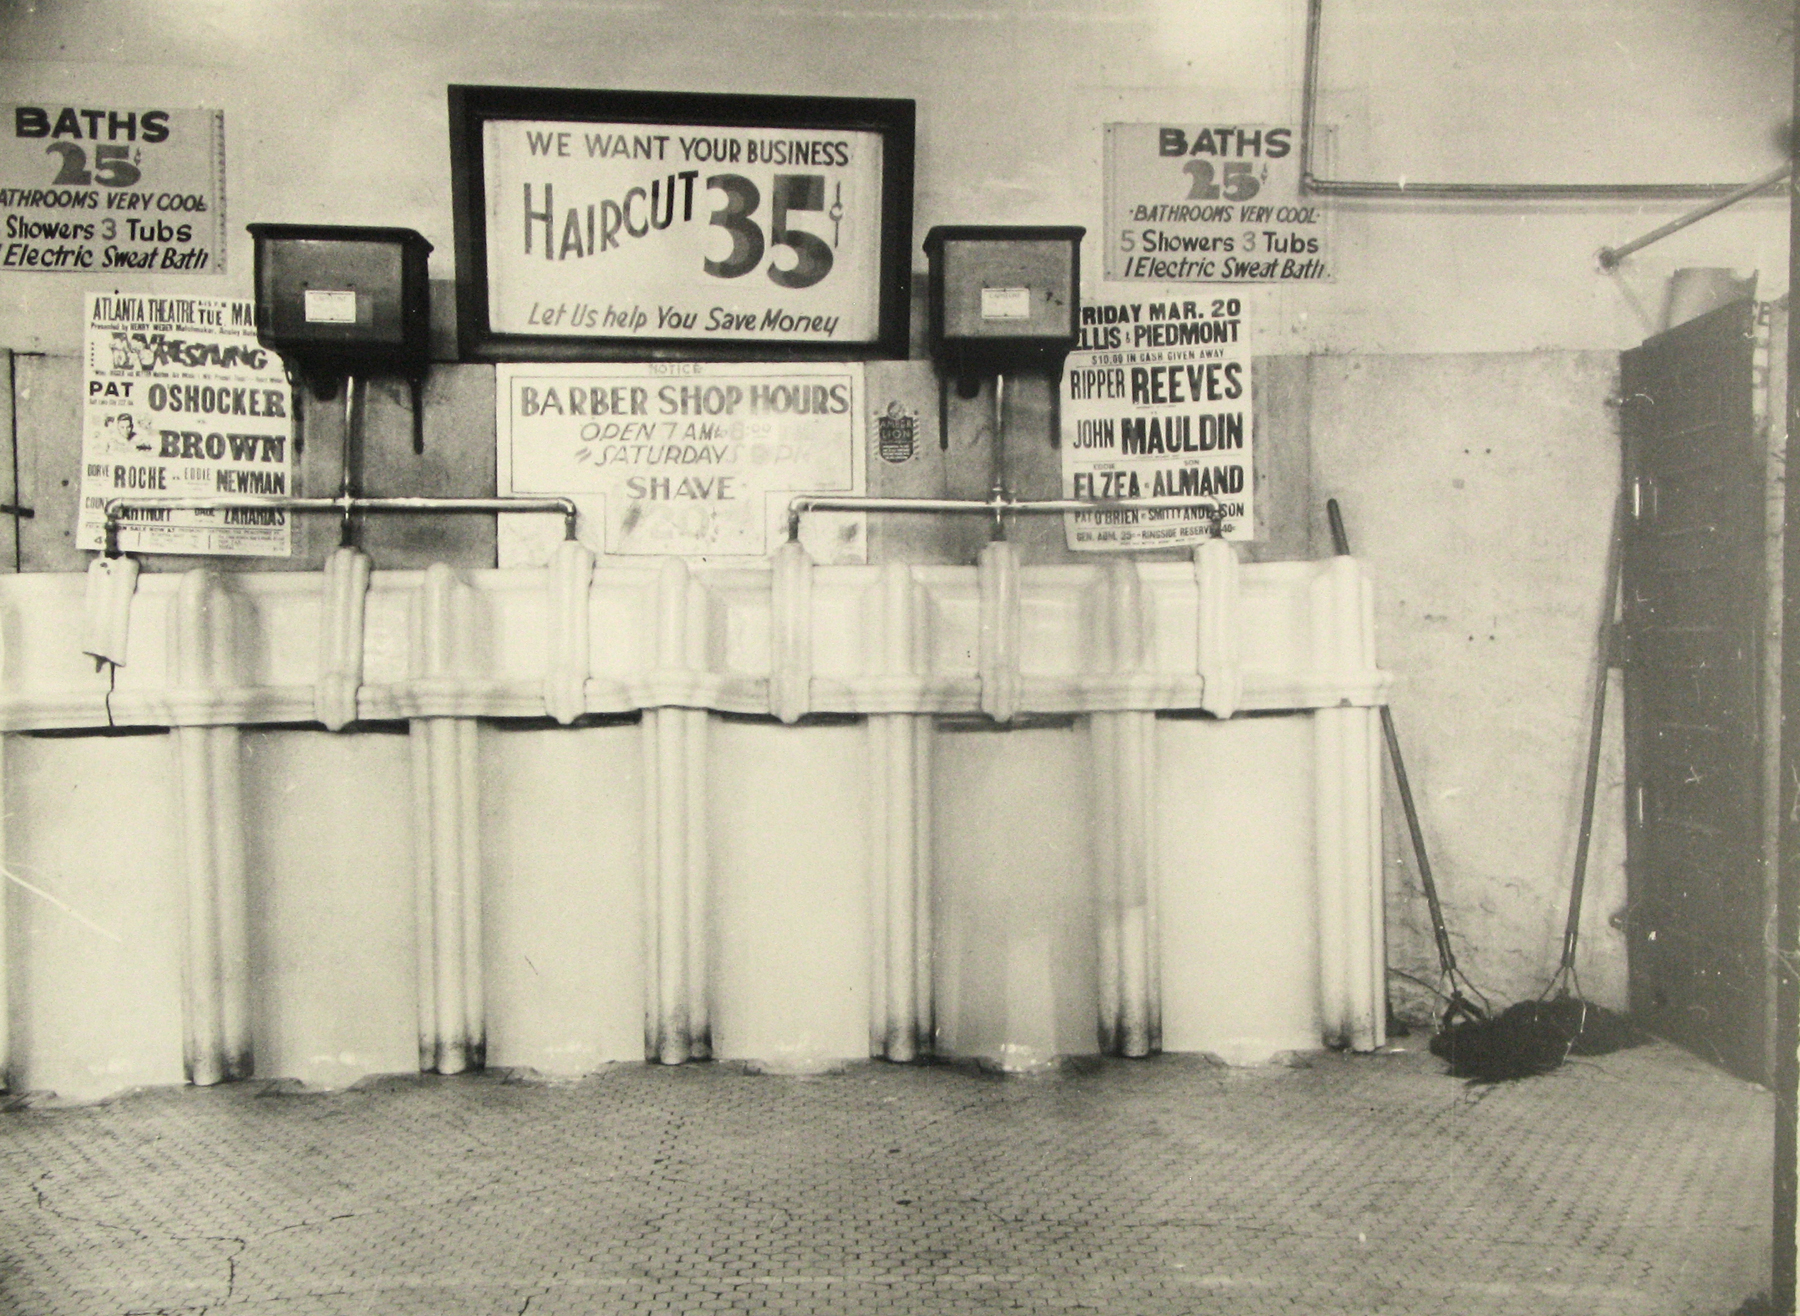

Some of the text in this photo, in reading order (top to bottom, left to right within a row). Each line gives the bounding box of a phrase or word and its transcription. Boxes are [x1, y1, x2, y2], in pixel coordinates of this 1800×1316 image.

[16, 107, 169, 143] BATHS
[526, 131, 849, 167] WE WANT YOUR BUSINESS
[1159, 127, 1292, 158] BATHS
[106, 192, 154, 210] VERY
[523, 169, 699, 261] HAIRCUT
[1240, 206, 1273, 223] VERY
[7, 214, 192, 242] Showers 3 Tubs
[1120, 228, 1319, 254] 5 Showers 3 Tubs
[3, 244, 208, 269] Electric Sweat Bath
[1134, 256, 1215, 279] Electric
[1221, 257, 1280, 279] Sweat
[93, 297, 144, 322] ATLANTA
[148, 298, 196, 324] THEATRE
[528, 302, 840, 338] Let Us help You Save Money
[1080, 298, 1241, 325] RIDAY MAR. 20
[1134, 319, 1241, 347] PIEDMONT
[1127, 353, 1136, 363] IN
[1140, 352, 1163, 362] CASH
[1168, 350, 1195, 360] GIVEN
[1200, 348, 1224, 358] AWAY
[89, 380, 133, 397] PAT
[1070, 362, 1243, 404] RIPPER REEVES
[520, 383, 850, 417] BARBER SHOP HOURS
[581, 422, 656, 441] OPEN
[662, 421, 678, 440] 7
[1073, 412, 1244, 455] JOHN MAULDIN
[158, 430, 286, 463] BROWN
[114, 465, 167, 490] ROCHE
[184, 467, 211, 481] EDDIE
[216, 469, 285, 495] NEWMAN
[627, 476, 736, 500] SHAVE
[1153, 465, 1244, 497] ALMAND
[1075, 510, 1092, 523] PAT
[1148, 507, 1180, 521] SMITTY
[1183, 502, 1244, 521] ANDESON
